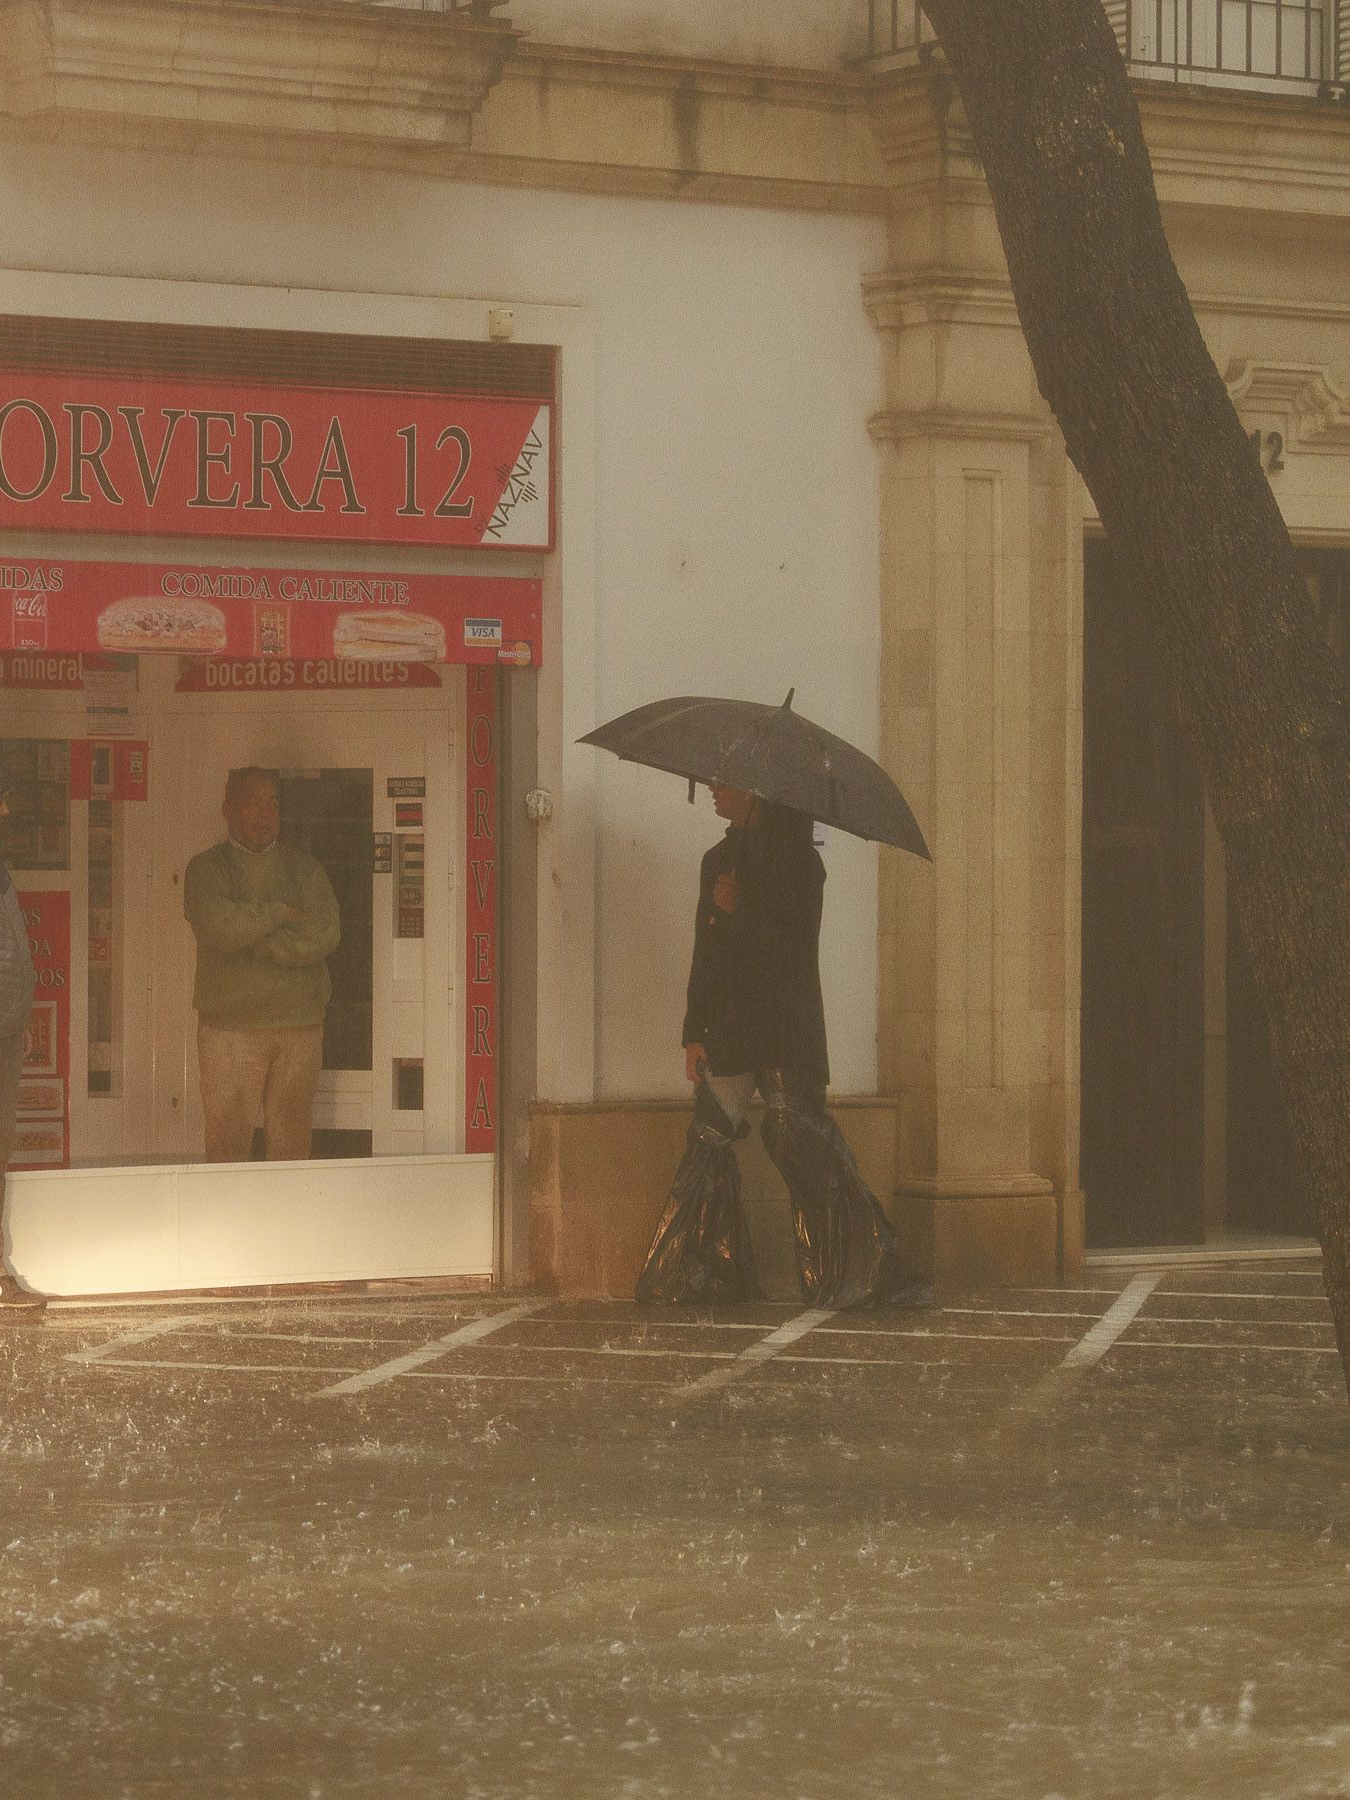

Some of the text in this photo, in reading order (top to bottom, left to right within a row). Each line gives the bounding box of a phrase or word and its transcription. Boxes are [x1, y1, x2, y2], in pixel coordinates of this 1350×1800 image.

[396, 423, 475, 519] 12
[486, 428, 543, 539] NAZNAV
[161, 571, 410, 606] COMIDA CALIENTE
[470, 627, 495, 638] VISA
[11, 652, 84, 681] mineral
[205, 657, 410, 688] bocatas calientes
